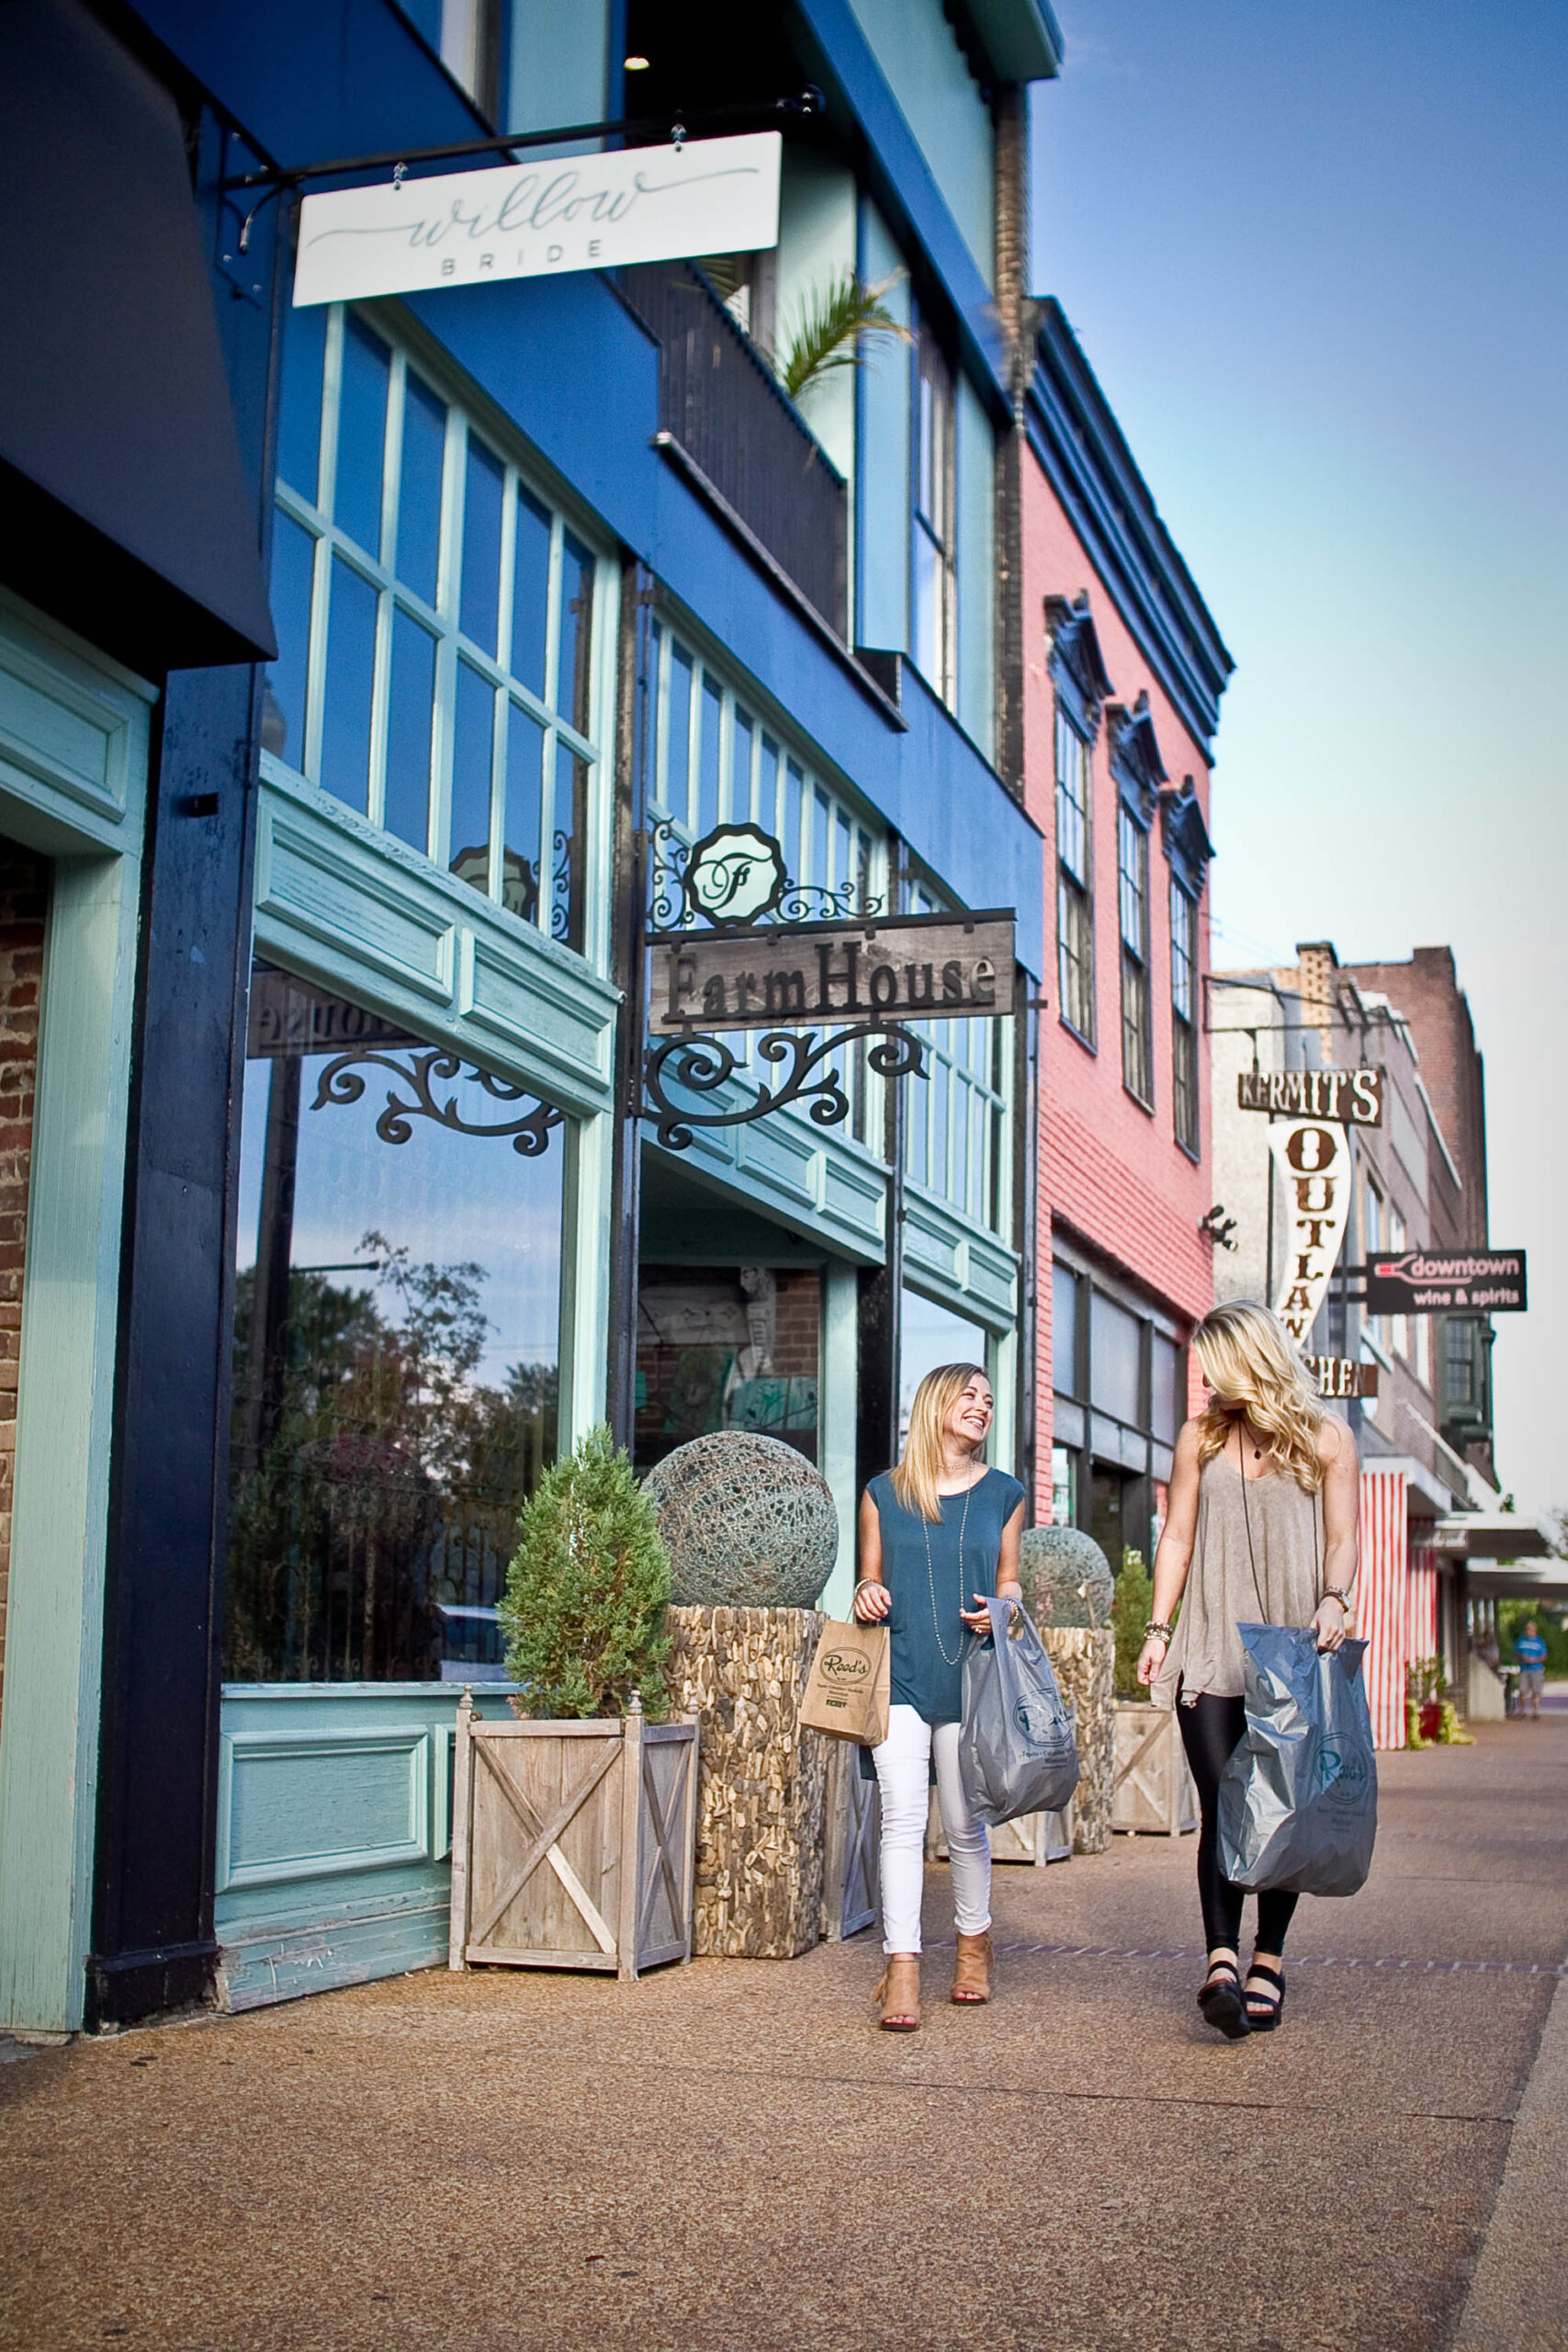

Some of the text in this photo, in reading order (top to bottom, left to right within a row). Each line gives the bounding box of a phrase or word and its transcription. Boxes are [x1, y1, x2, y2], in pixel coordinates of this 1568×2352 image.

[307, 167, 759, 247] willow
[441, 239, 603, 277] BRIDE
[667, 941, 997, 1016] FarmHouse
[1241, 1070, 1379, 1122] KERMIT'S
[1411, 1256, 1520, 1277] downtown
[1414, 1288, 1520, 1307] wine & spirits
[824, 1655, 867, 1676] Reed's
